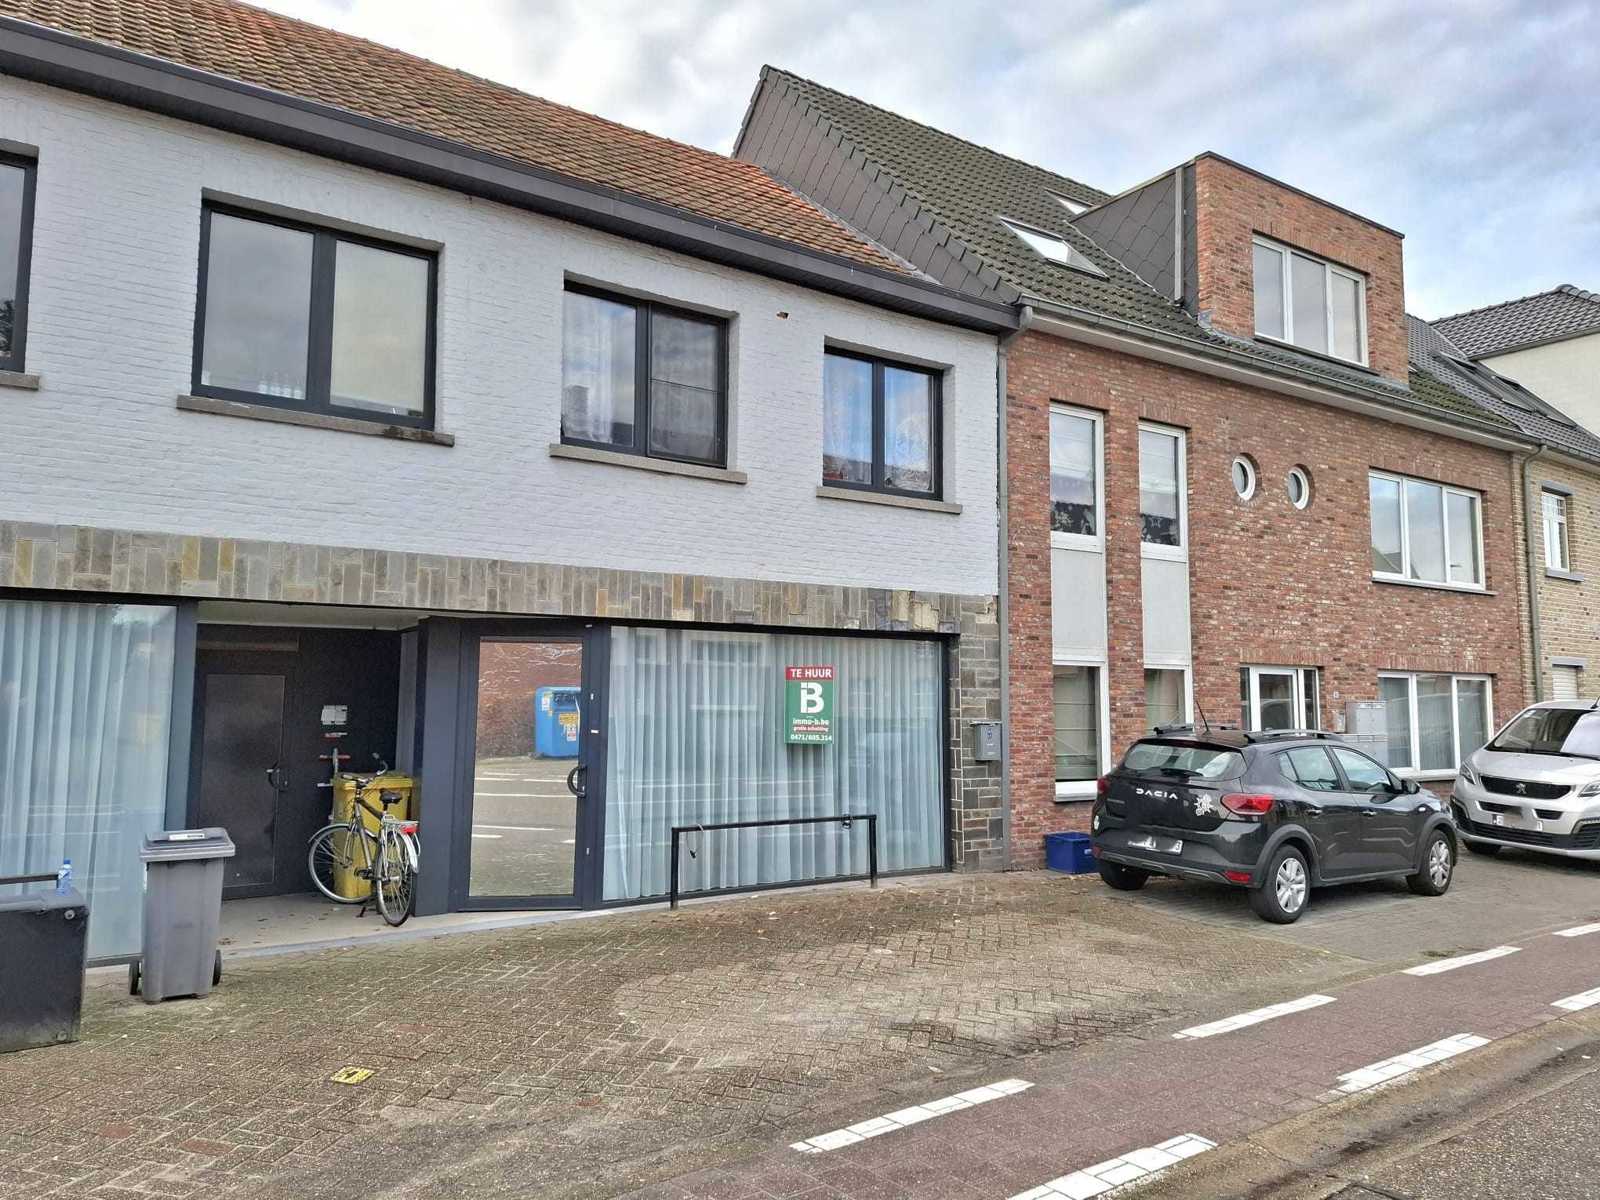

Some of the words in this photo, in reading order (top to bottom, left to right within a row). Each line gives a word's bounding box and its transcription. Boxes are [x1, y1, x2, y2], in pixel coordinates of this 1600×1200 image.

[790, 668, 802, 678] TE
[805, 668, 832, 678] HUUR
[1135, 788, 1178, 800] DACIA
